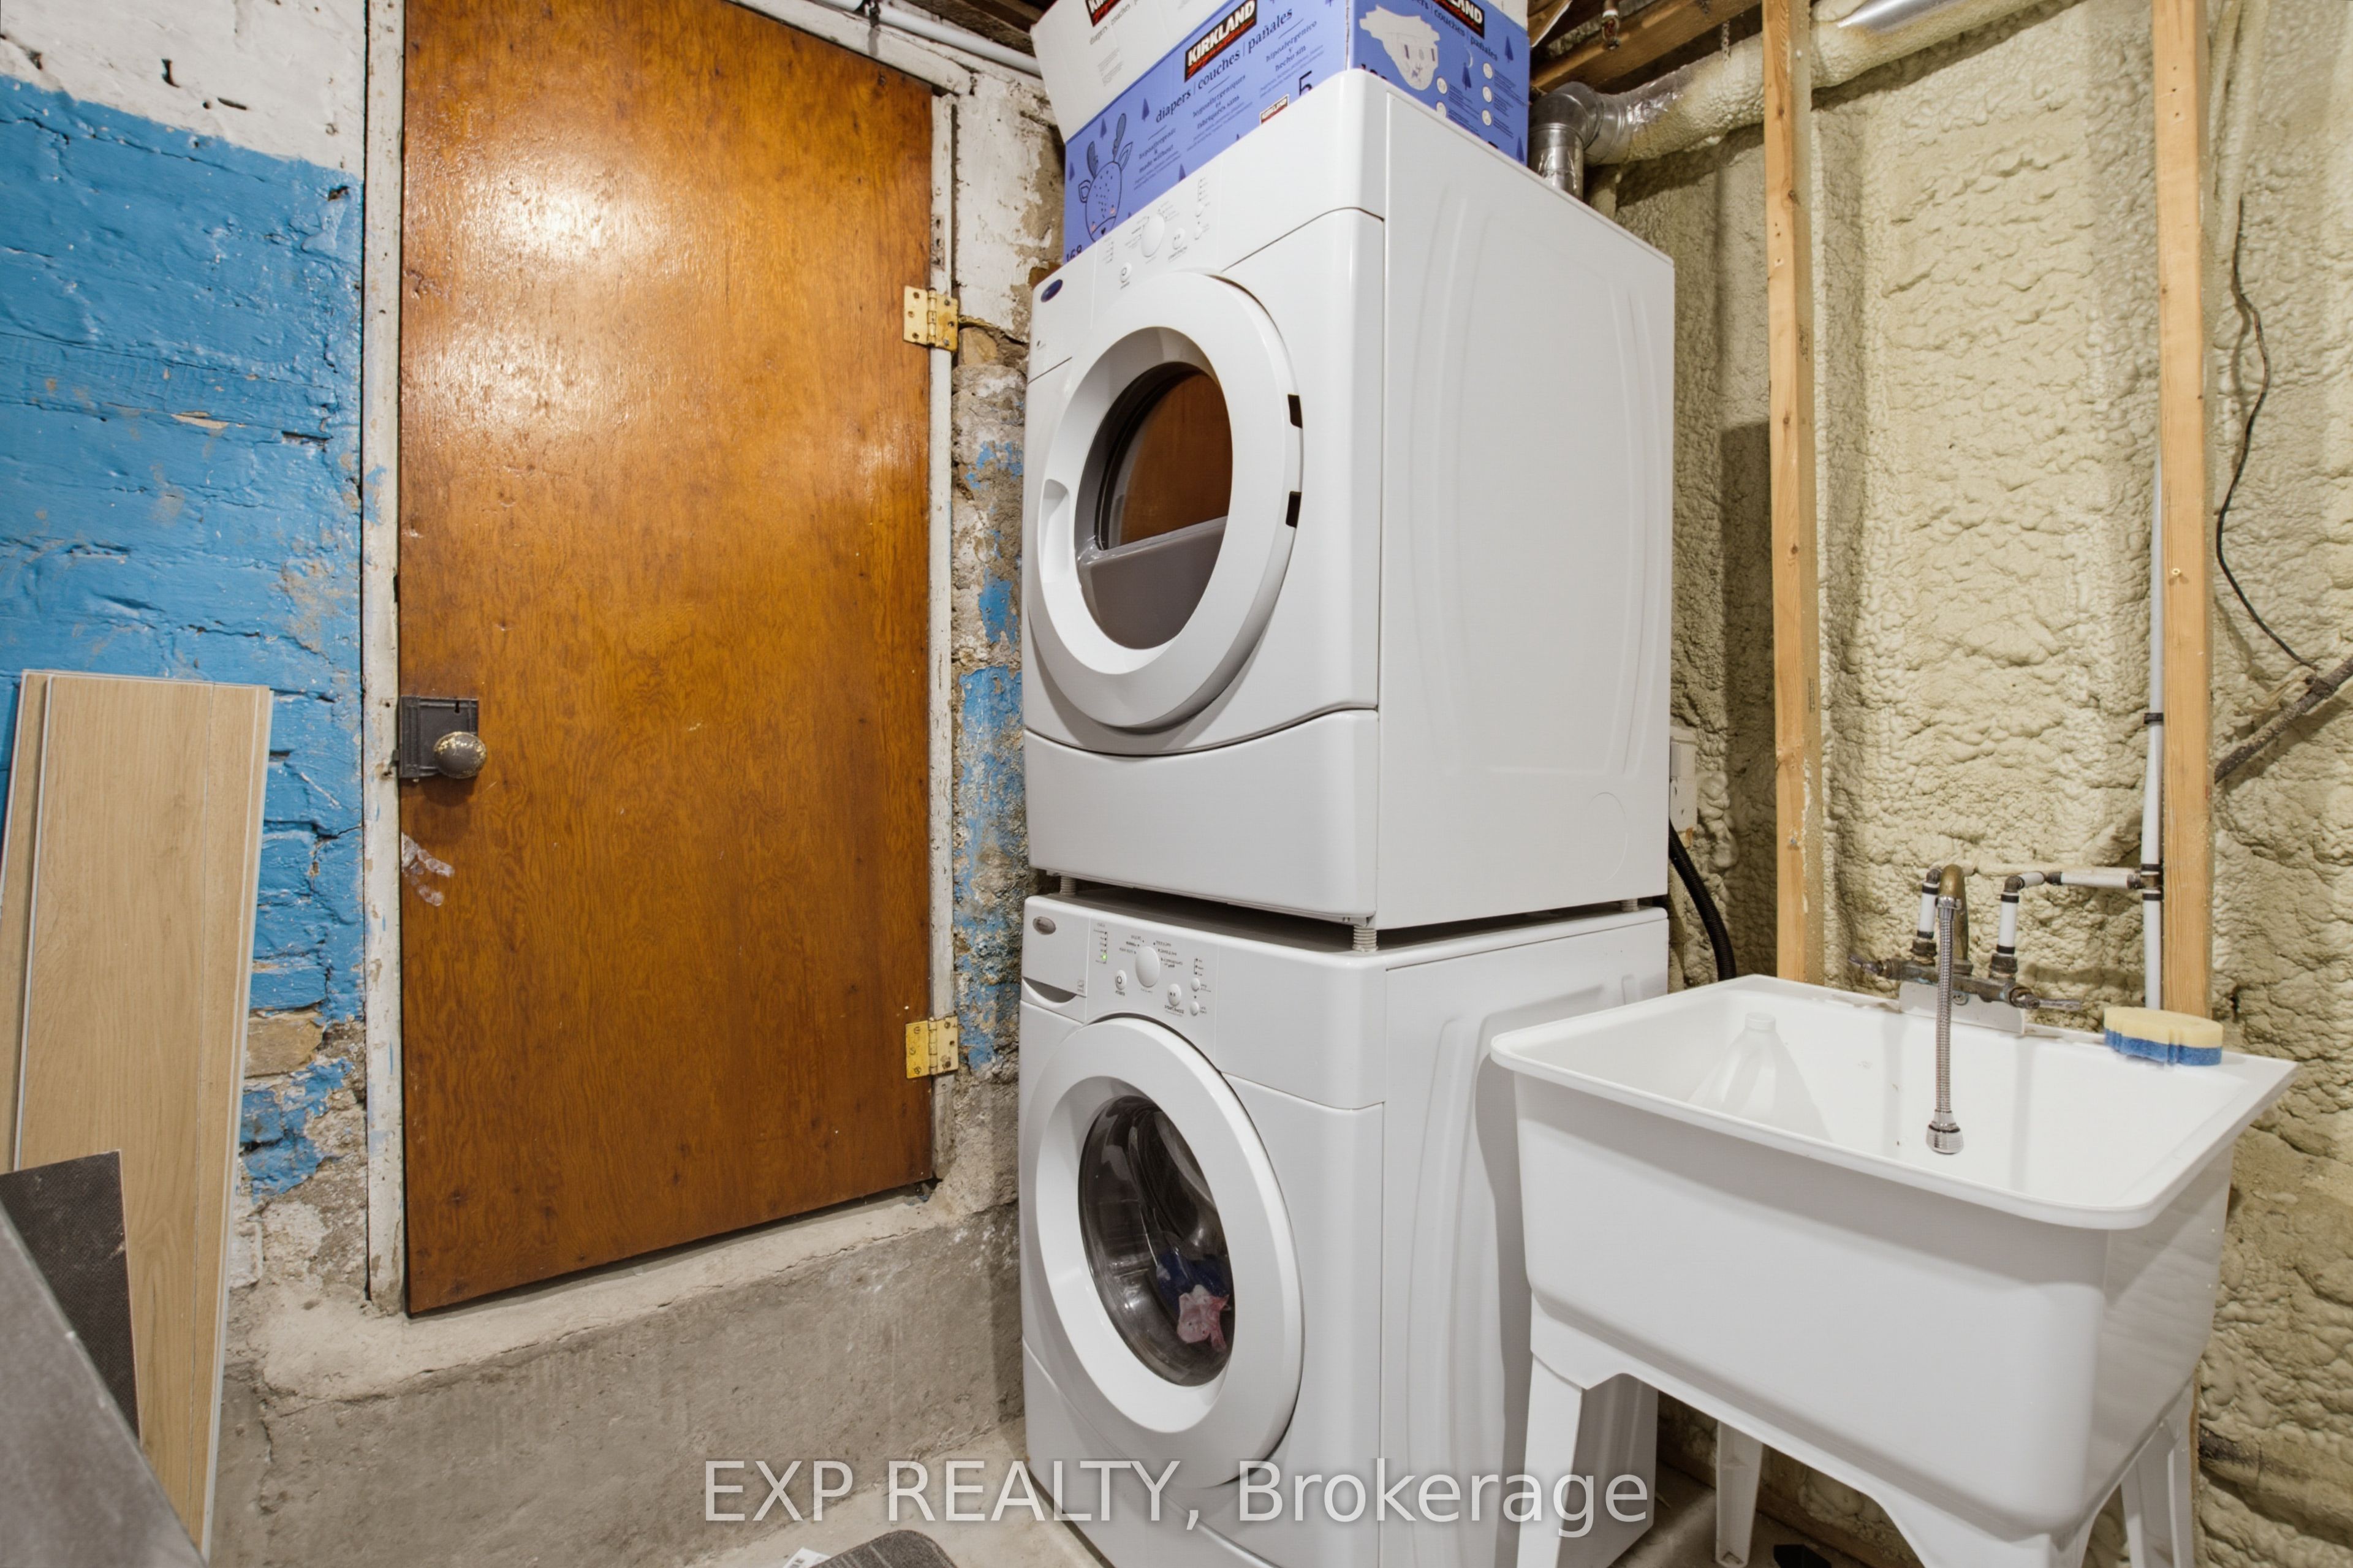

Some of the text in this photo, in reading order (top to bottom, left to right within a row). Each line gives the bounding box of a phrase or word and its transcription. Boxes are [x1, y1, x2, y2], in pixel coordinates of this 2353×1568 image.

[1156, 89, 1191, 123] diapers
[1197, 49, 1240, 90] couches
[1248, 8, 1293, 54] pañales
[1188, 0, 1256, 67] KIRKLAND
